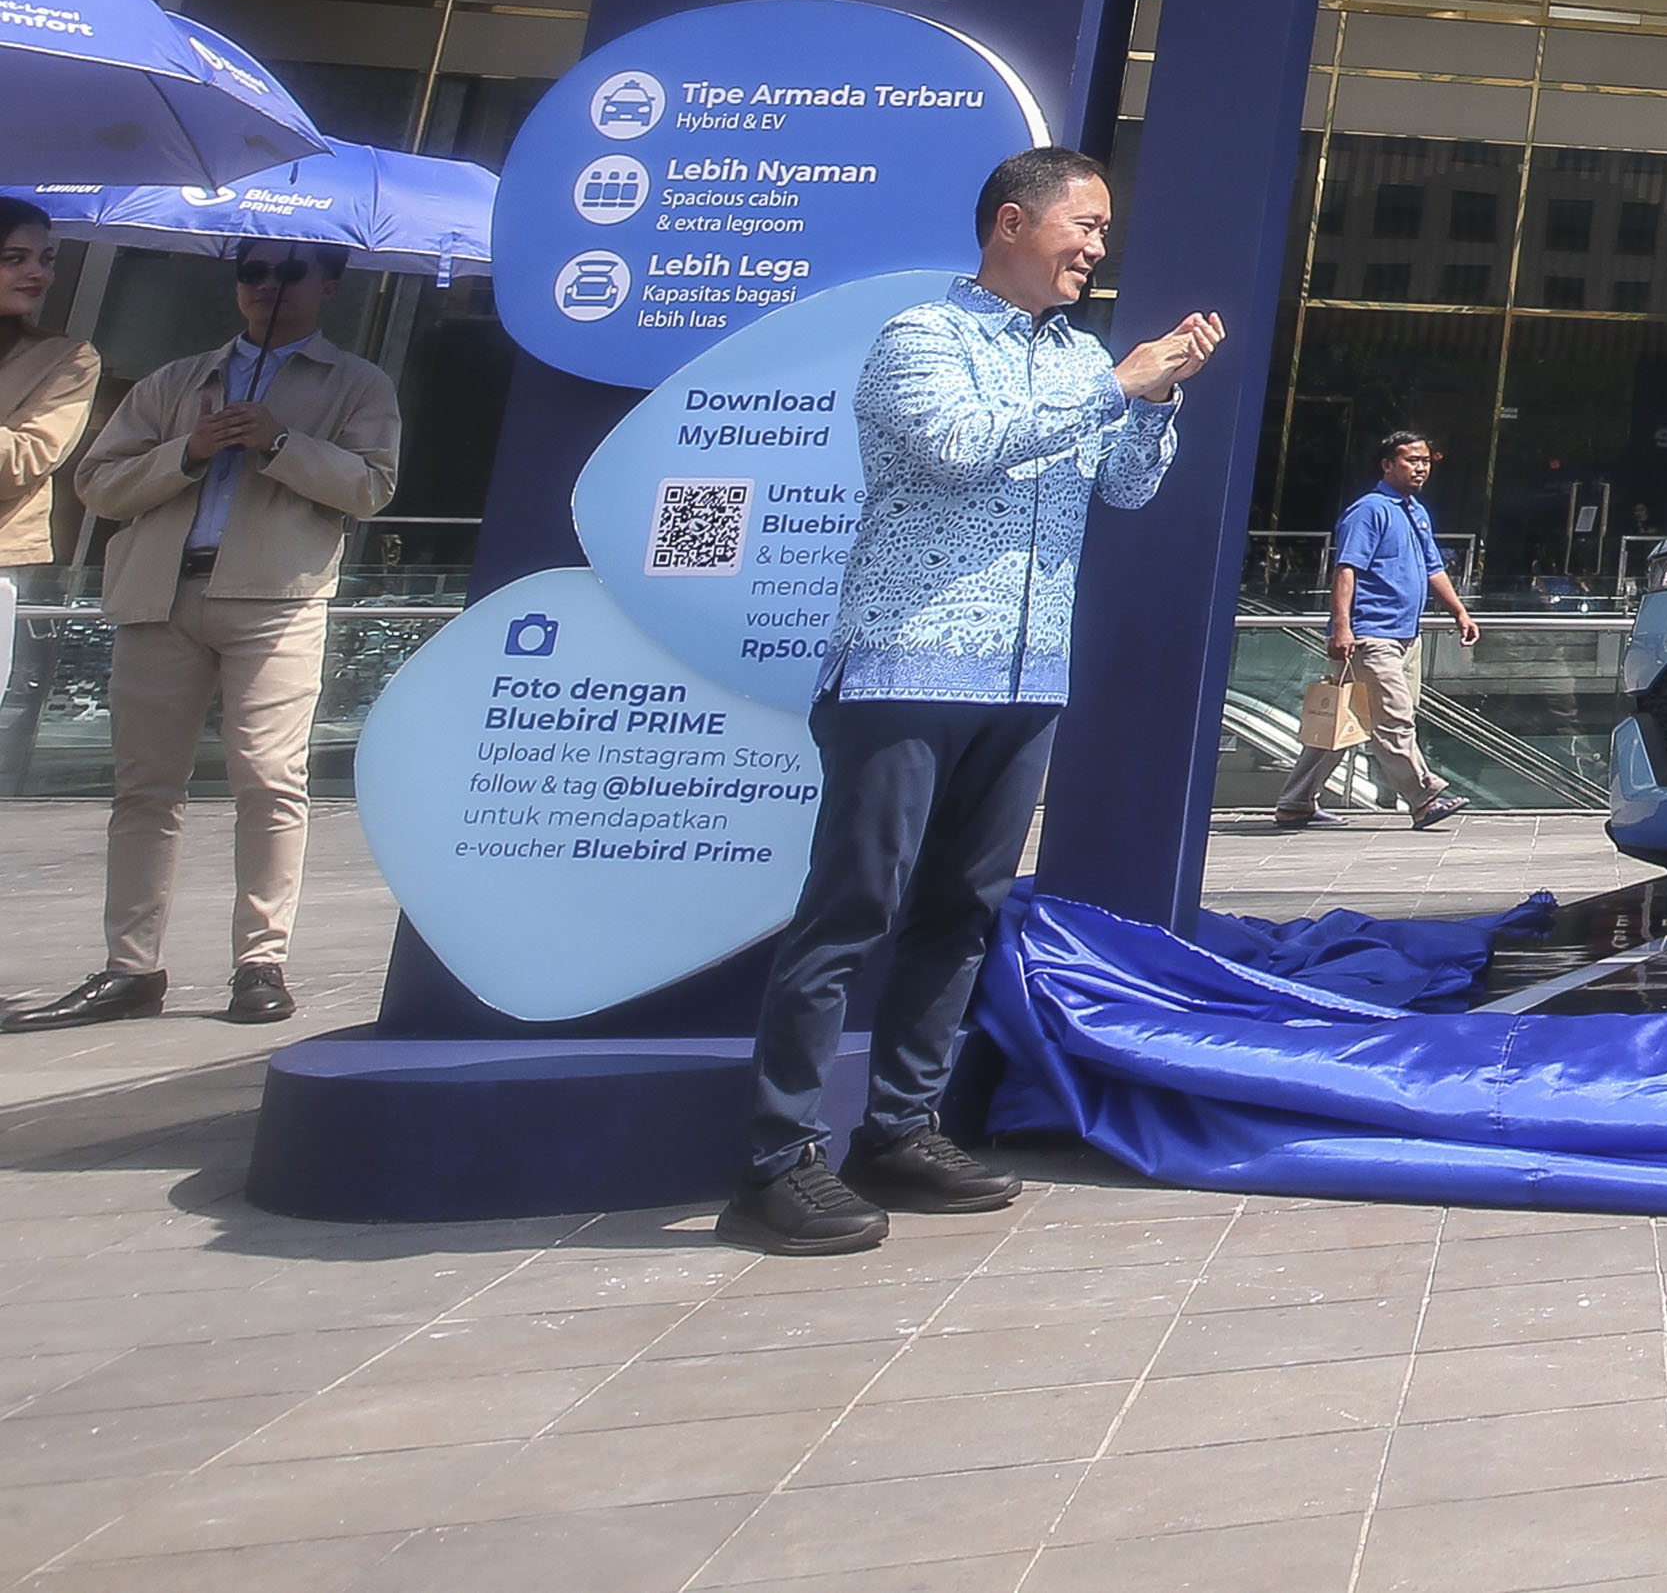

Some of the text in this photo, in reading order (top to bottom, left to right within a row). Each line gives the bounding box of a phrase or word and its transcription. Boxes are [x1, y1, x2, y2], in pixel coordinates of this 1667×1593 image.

[0, 11, 94, 37] mfort
[682, 82, 984, 108] Tipe Armada Terbaru
[676, 112, 786, 132] Hybrid & EV
[667, 159, 877, 187] Lebih Nyaman
[239, 200, 295, 215] PRIME
[244, 188, 332, 209] Bluebird
[661, 189, 799, 209] Spacious cabin
[656, 214, 804, 236] & extra legroom
[648, 254, 810, 282] Lebih Lega
[642, 286, 796, 306] Kapasitas bagasi
[638, 310, 727, 328] lebih luas
[686, 389, 836, 412] Download
[678, 425, 830, 449] MyBluebird
[768, 484, 846, 504] Untuk
[756, 545, 848, 565] & berke
[751, 577, 838, 597] menda
[746, 609, 830, 628] voucher
[741, 639, 827, 663] Rp50.0
[492, 675, 687, 707] Foto dengan
[485, 707, 726, 736] Bluebird PRIME
[477, 742, 802, 773] Upload ke Instagram Story,
[469, 773, 818, 804] follow & tag @bluebirdgroup
[464, 806, 728, 833] untuk mendapatkan
[455, 839, 773, 864] e-voucher Bluebird Prime
